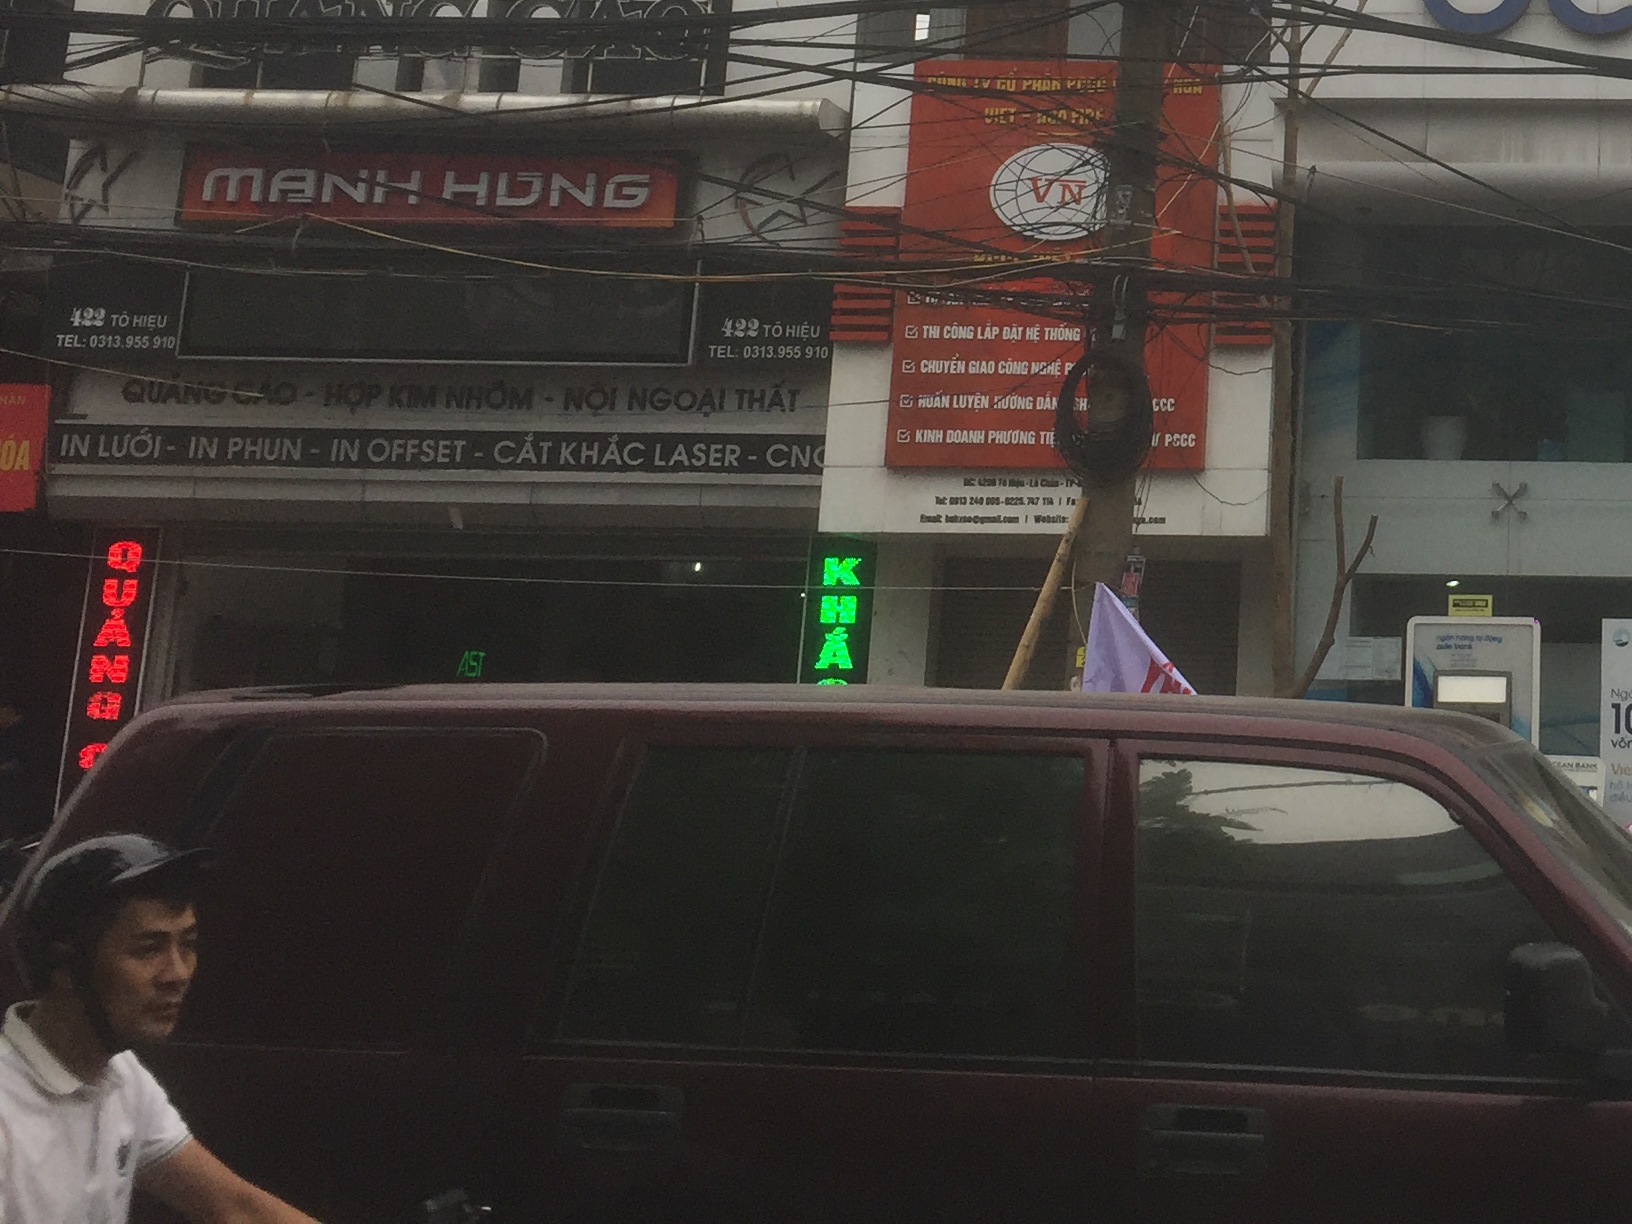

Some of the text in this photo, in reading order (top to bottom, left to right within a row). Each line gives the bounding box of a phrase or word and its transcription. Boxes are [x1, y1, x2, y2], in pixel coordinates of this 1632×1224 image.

[202, 166, 421, 206] MẠNH
[1029, 176, 1087, 206] VN
[70, 307, 106, 327] 422
[721, 317, 759, 337] 422
[785, 321, 821, 342] HIỆU
[56, 335, 176, 349] TEL: 0313.955 910
[922, 325, 943, 339] THI
[945, 322, 975, 340] CÔNG
[1025, 322, 1041, 343] HỆ
[1042, 322, 1081, 341] THỐNG
[708, 345, 829, 359] TEL: 0313.955 910
[920, 353, 966, 374] CHUYỂN
[968, 360, 995, 375] GIAO
[1030, 359, 1062, 378] NGHỆ
[322, 379, 382, 416] HỢP
[387, 381, 438, 409] KIM
[562, 382, 617, 417] NỘI
[626, 386, 726, 418] NGOẠI
[734, 378, 801, 413] THẤT
[917, 390, 951, 409] HUẤN
[952, 393, 990, 412] LUYỆN
[60, 432, 91, 458] IN
[187, 435, 218, 460] IN
[226, 436, 302, 461] PHUN
[330, 438, 360, 463] IN
[366, 439, 467, 465] OFFSET
[493, 432, 553, 466] CẮT
[558, 433, 646, 466] KHẮC
[653, 442, 742, 468] LASER
[914, 429, 943, 444] KINH
[946, 430, 985, 444] DOANH
[987, 429, 1035, 445] PHƯƠNG
[1039, 428, 1060, 448] TIỆ
[87, 540, 143, 721] QUẢNG
[813, 557, 862, 685] KHẮ
